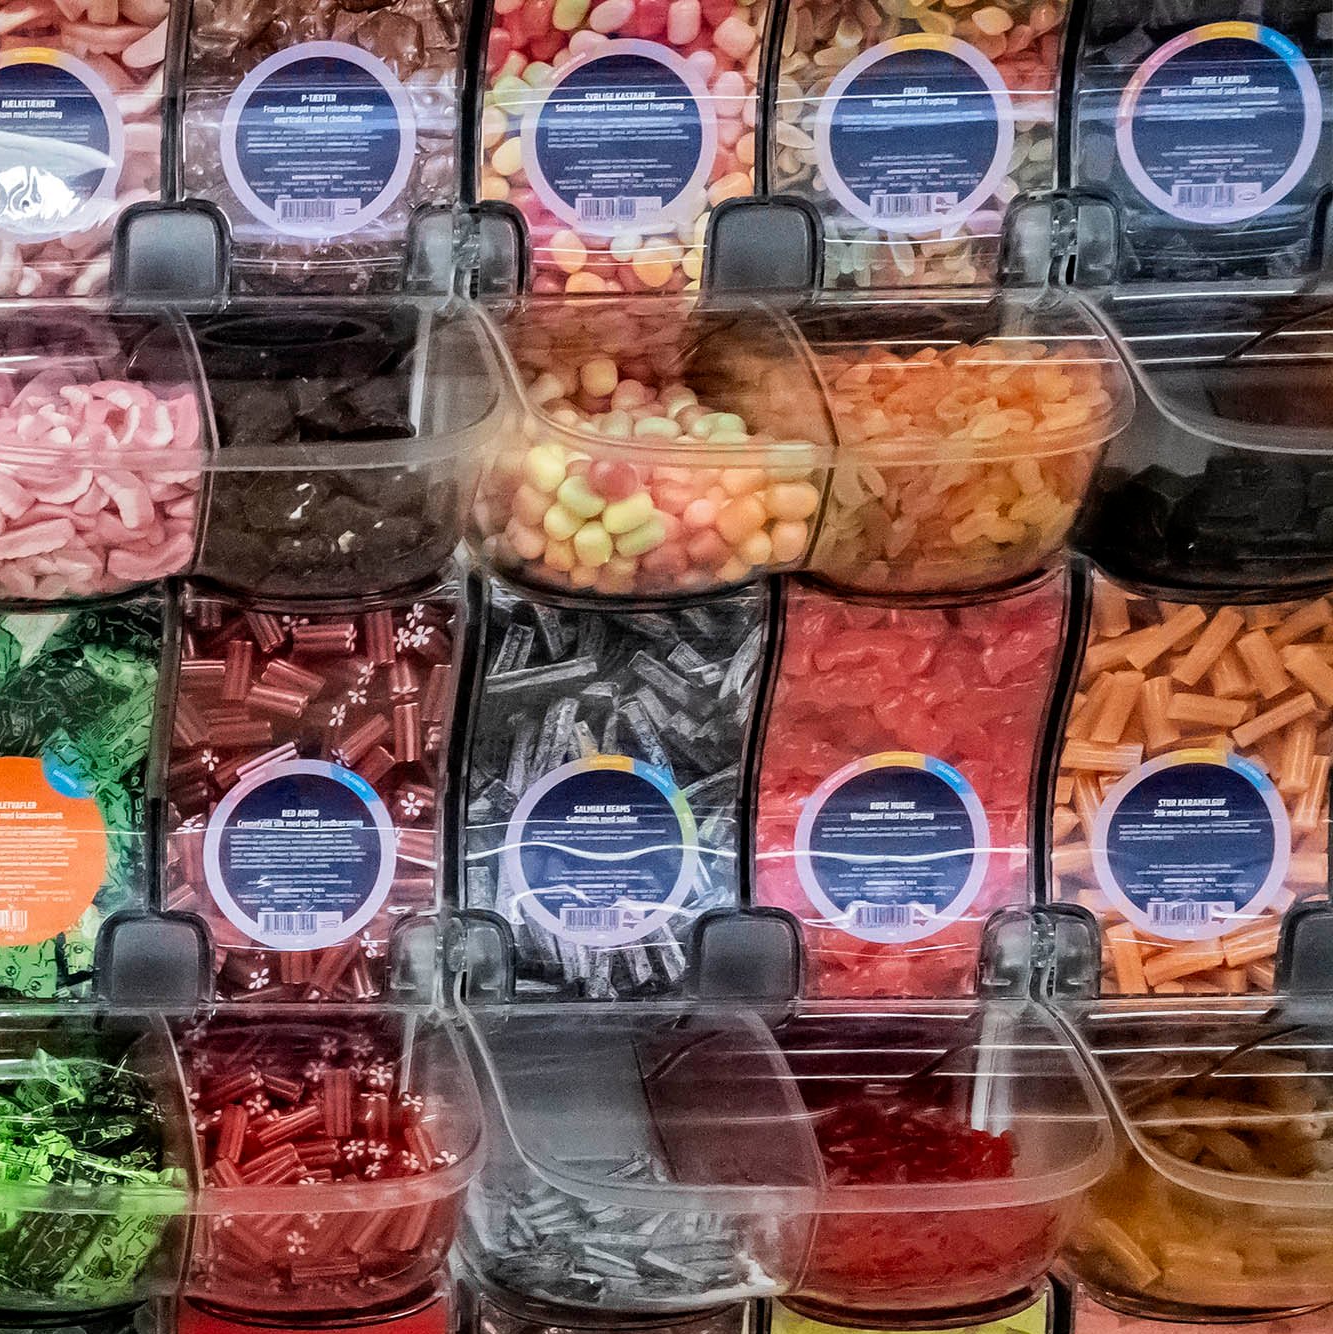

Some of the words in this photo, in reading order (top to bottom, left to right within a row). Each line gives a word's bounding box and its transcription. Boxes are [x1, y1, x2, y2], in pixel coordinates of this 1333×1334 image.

[2, 100, 55, 108] MÆLKETÆNDER
[282, 809, 296, 818] RED
[574, 805, 605, 814] SALMIAK
[606, 805, 630, 814] BEAMS
